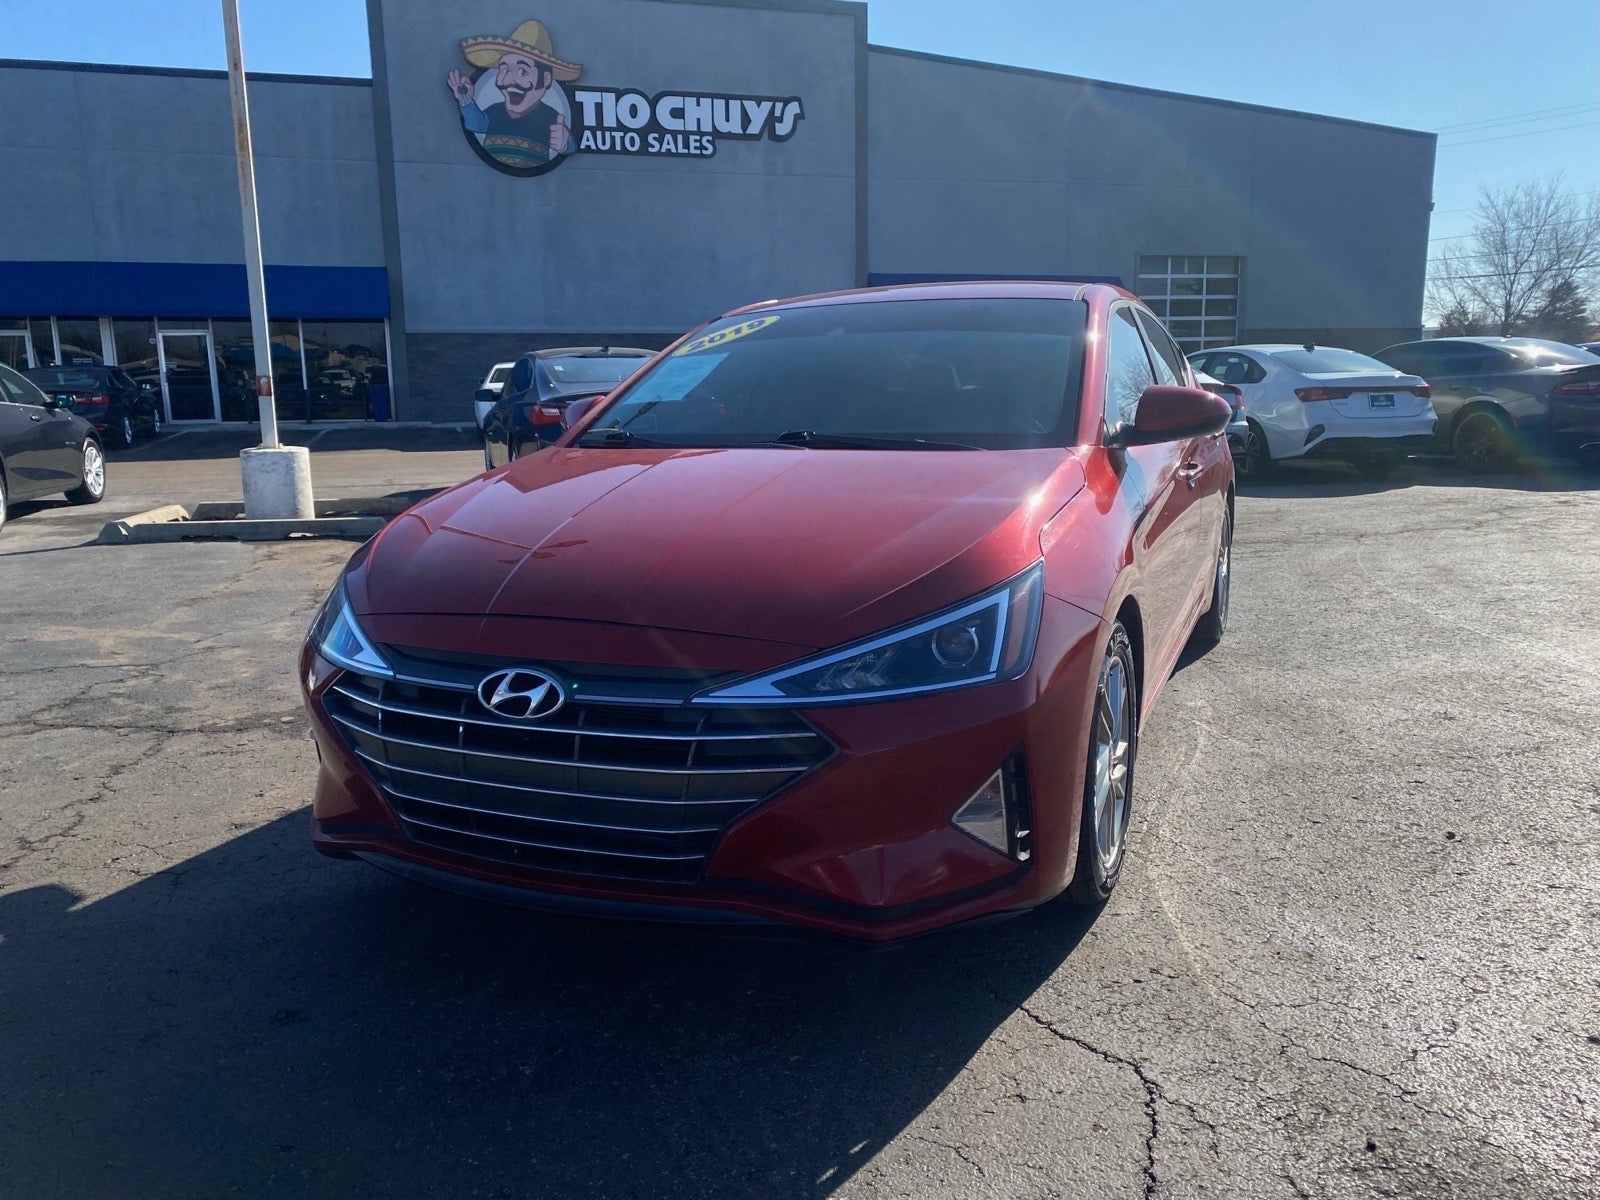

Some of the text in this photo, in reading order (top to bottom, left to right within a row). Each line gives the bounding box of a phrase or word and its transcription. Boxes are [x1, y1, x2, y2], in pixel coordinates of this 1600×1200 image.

[575, 90, 801, 136] TIO CHUY'S
[580, 130, 714, 155] AUTO SALES
[686, 319, 766, 353] 2019
